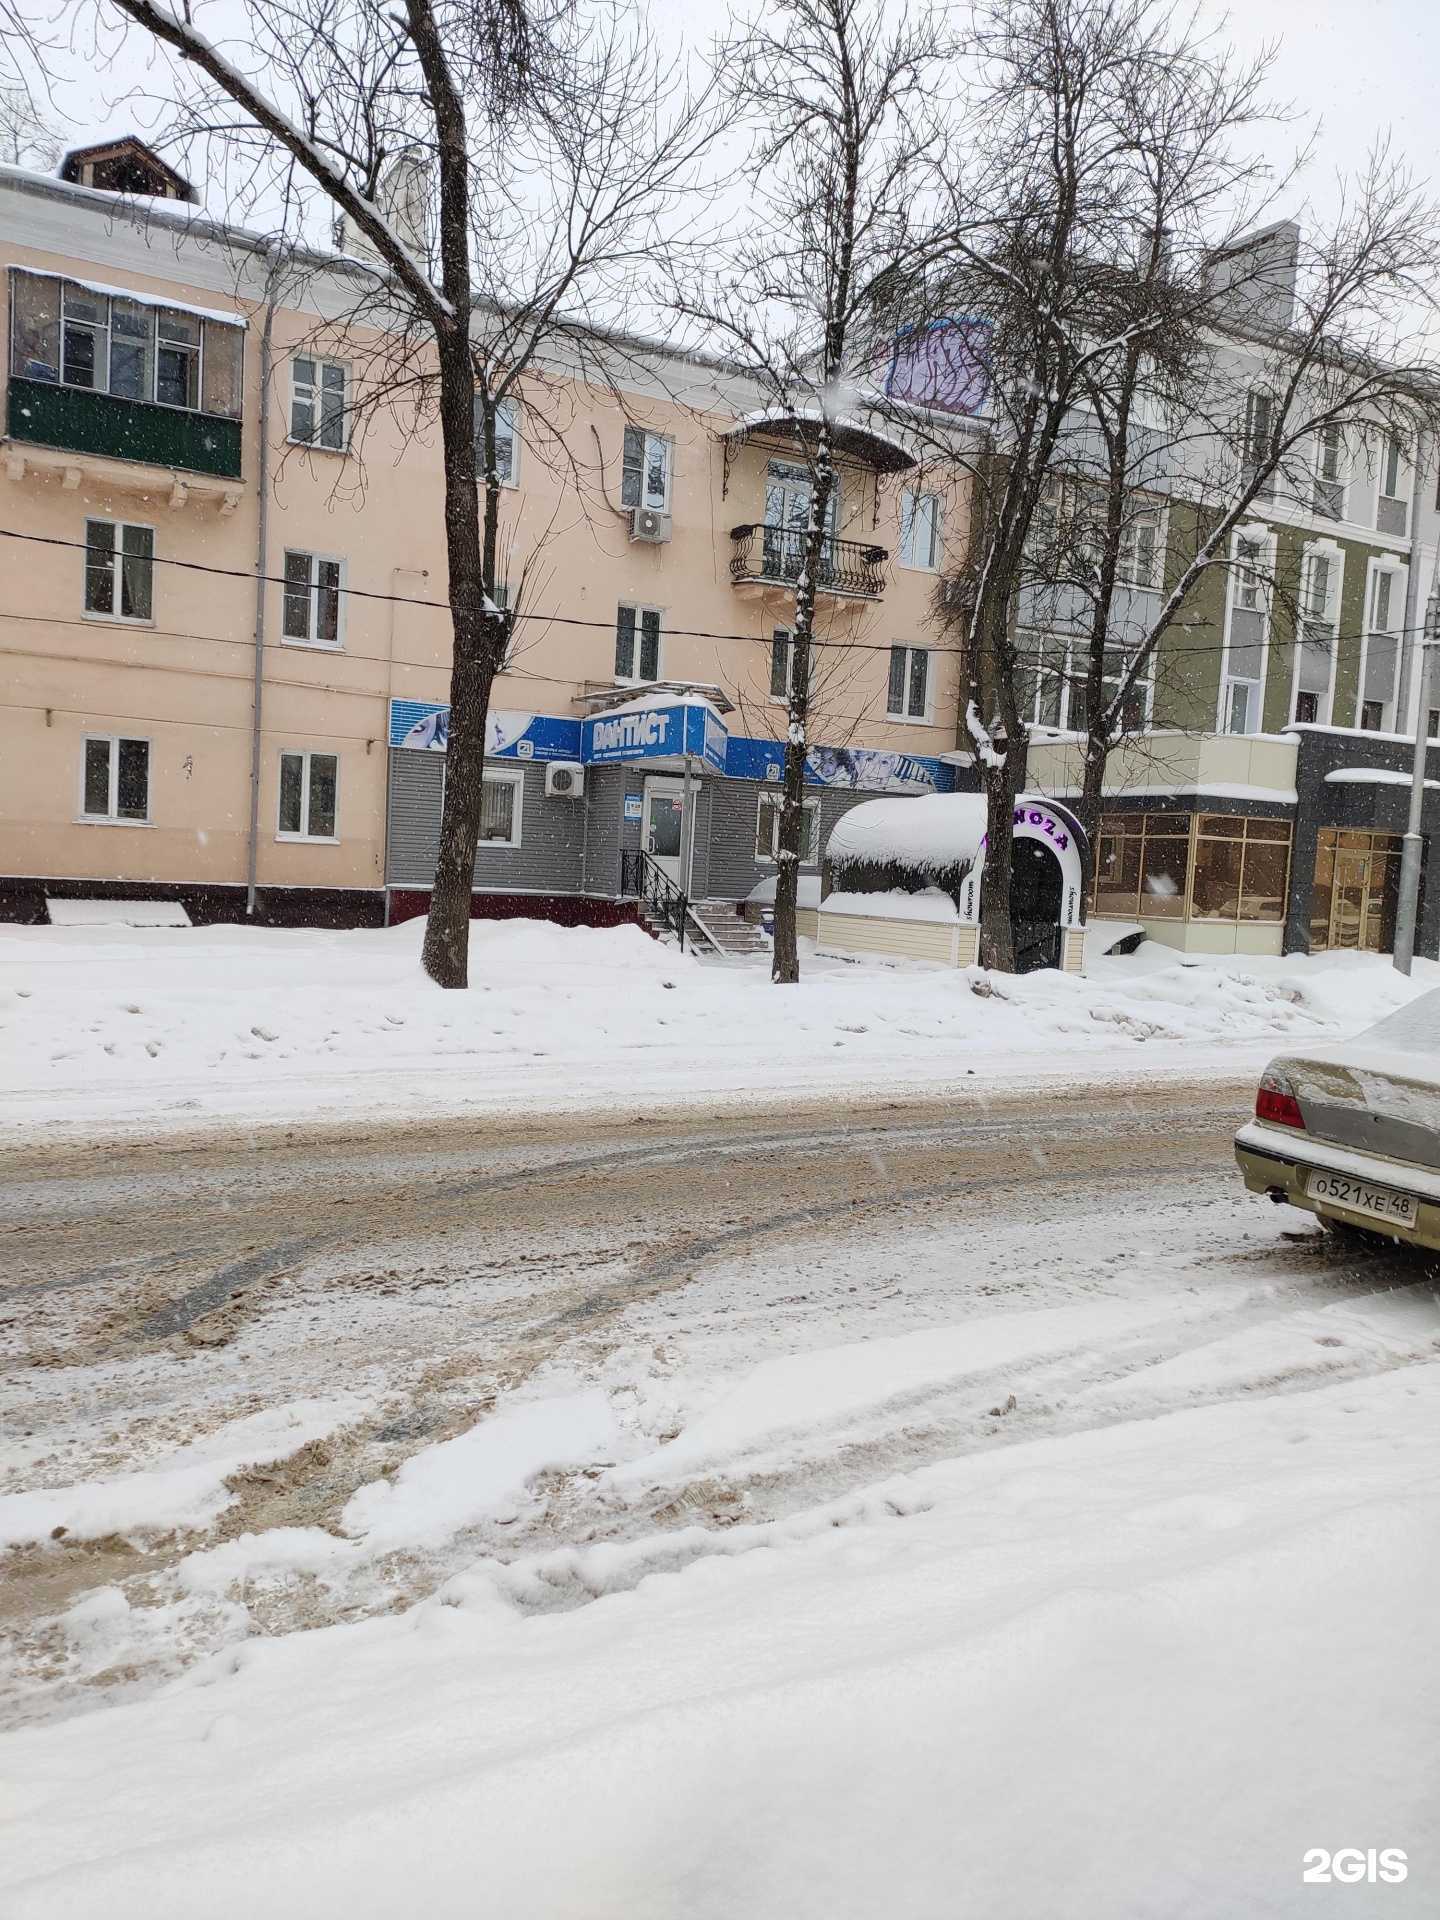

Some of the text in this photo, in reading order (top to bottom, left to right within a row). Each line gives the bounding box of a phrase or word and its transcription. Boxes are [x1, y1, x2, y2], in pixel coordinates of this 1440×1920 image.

[963, 880, 974, 921] showroom
[1067, 886, 1078, 924] showroom
[1391, 1195, 1411, 1213] 48
